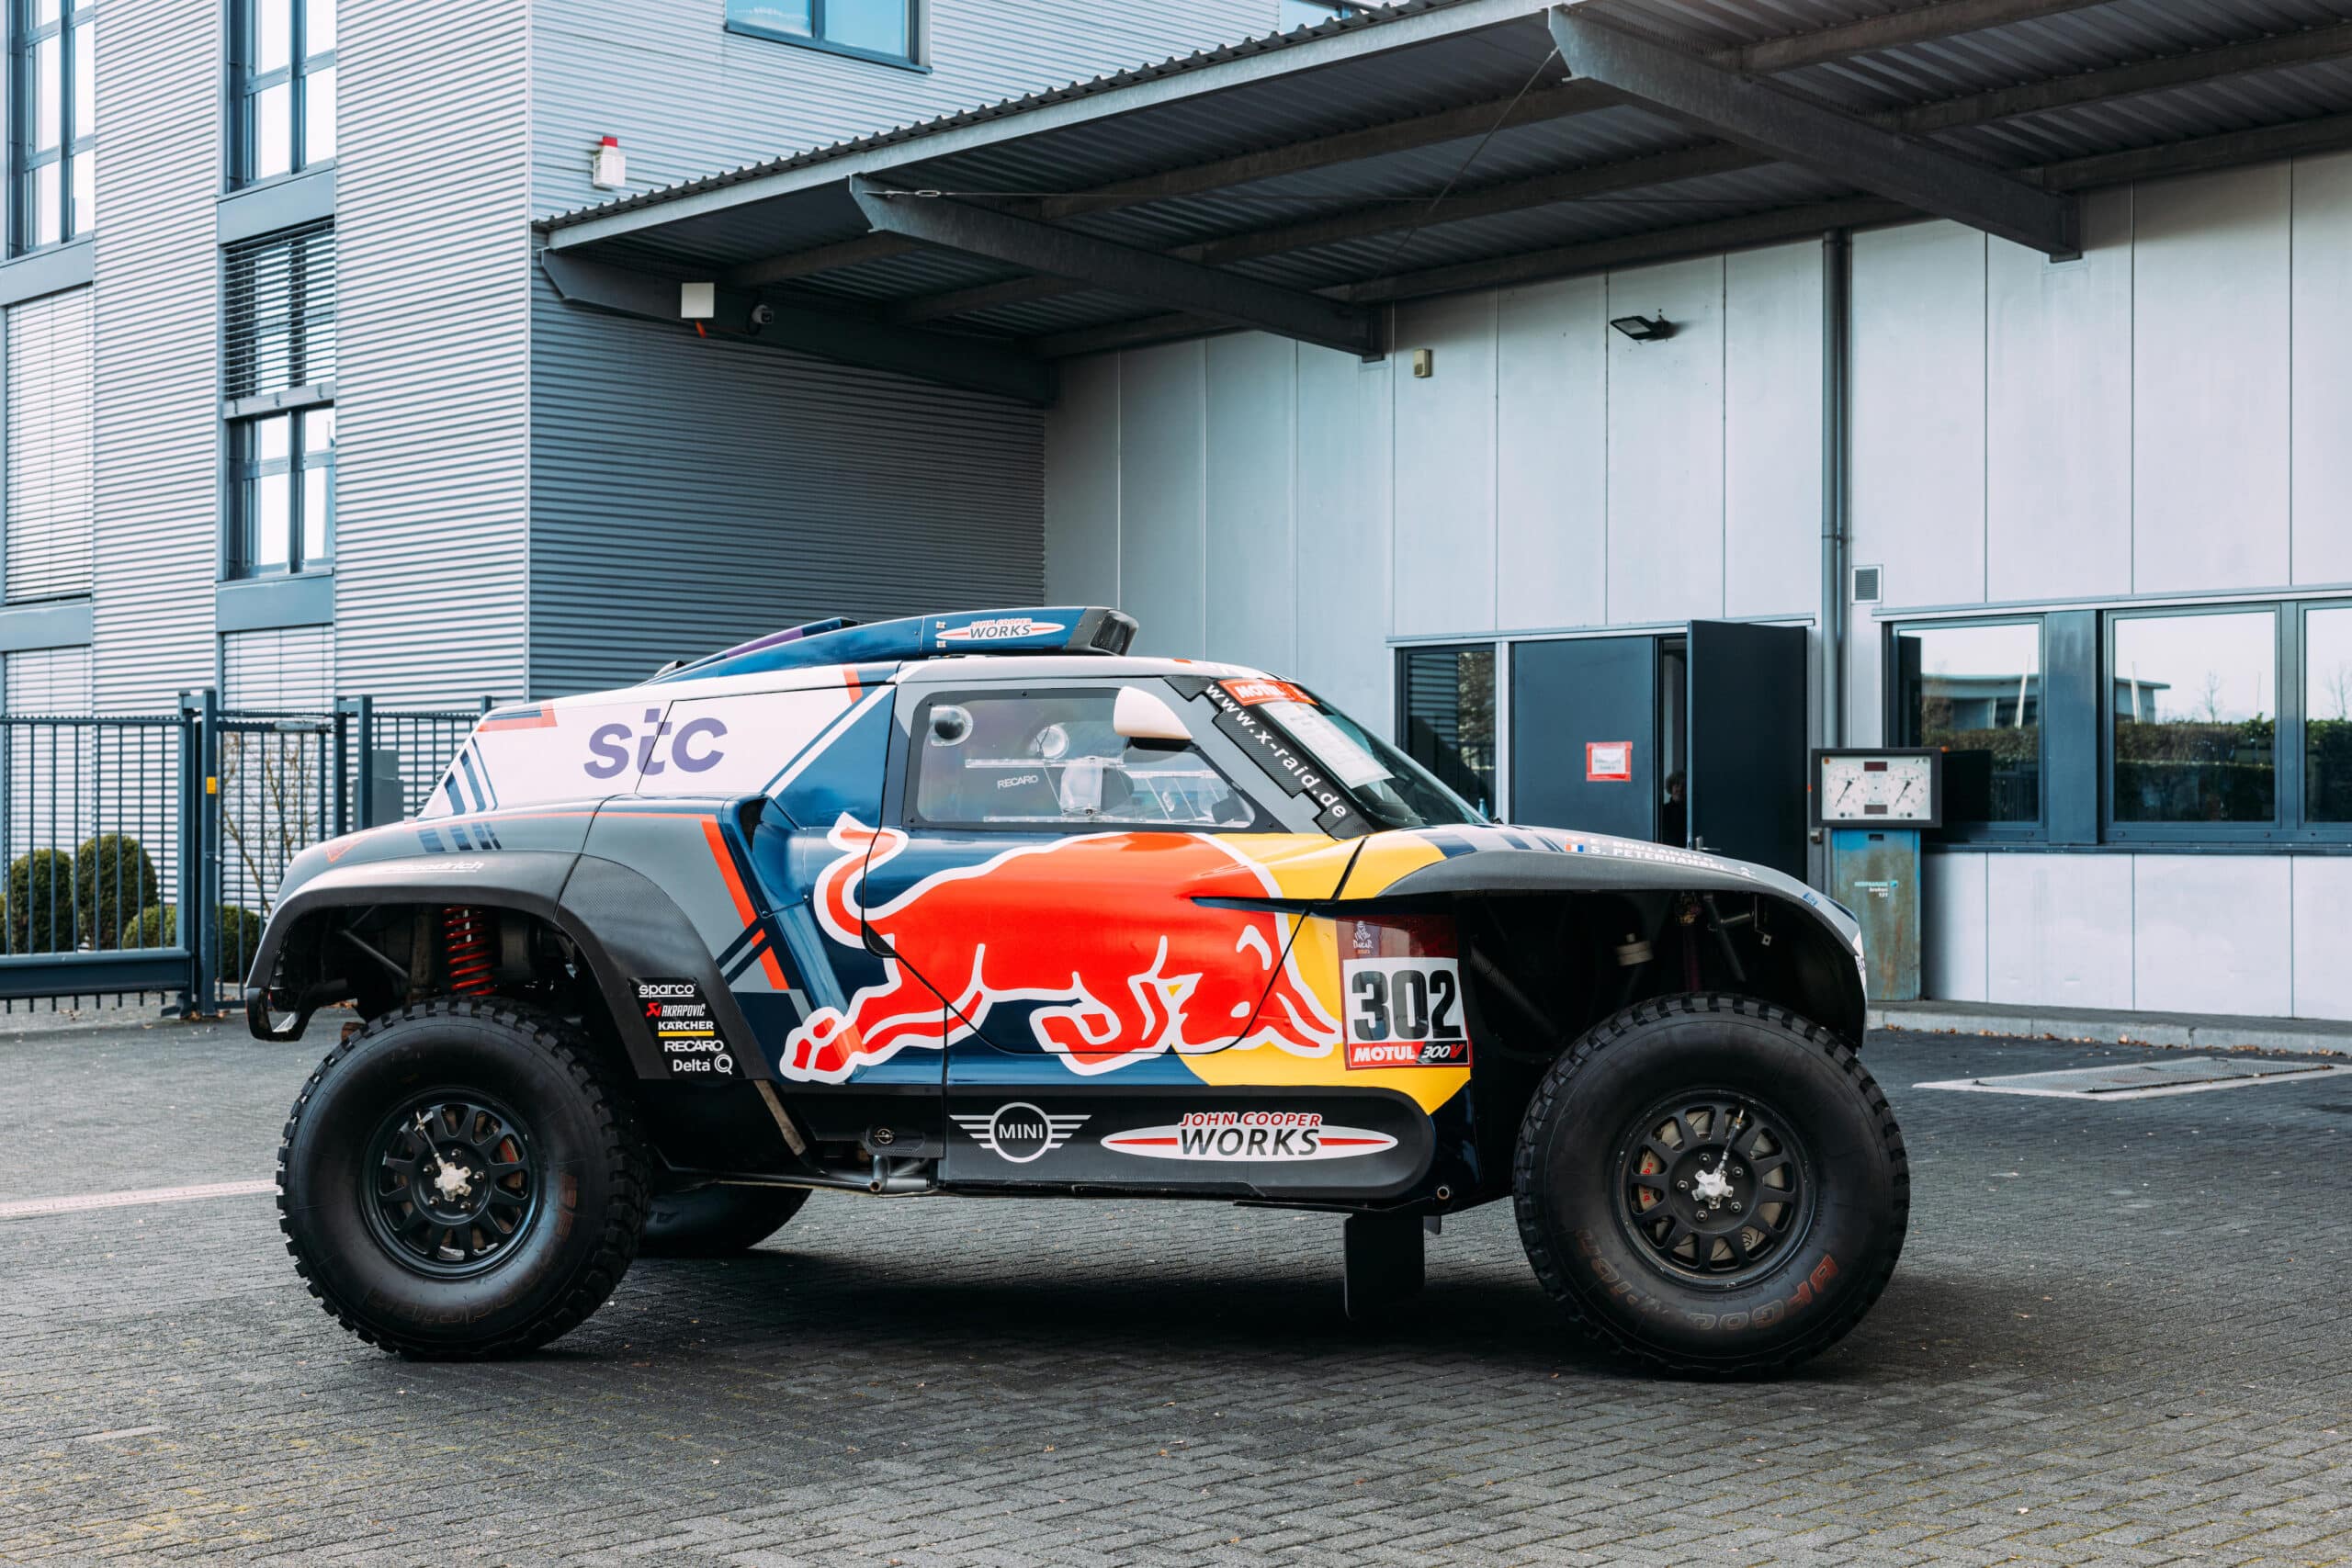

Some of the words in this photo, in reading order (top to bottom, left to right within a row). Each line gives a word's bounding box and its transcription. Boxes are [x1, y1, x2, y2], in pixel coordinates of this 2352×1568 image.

[970, 625, 1031, 638] WORKS
[1234, 683, 1286, 699] MOTUL
[583, 708, 728, 779] stc
[1205, 684, 1347, 818] www.x-raid.de
[997, 774, 1038, 789] RECARO
[639, 984, 695, 998] sparco
[1351, 969, 1463, 1042] 302
[658, 1021, 714, 1031] KÄRCHER
[664, 1040, 724, 1053] RECARO
[1353, 1046, 1417, 1062] MOTUL
[1421, 1043, 1464, 1059] 300V
[673, 1058, 710, 1072] Delta
[1180, 1113, 1232, 1127] JOHN
[1242, 1112, 1320, 1126] COOPER
[1000, 1123, 1043, 1139] MINI
[1181, 1128, 1319, 1156] WORKS
